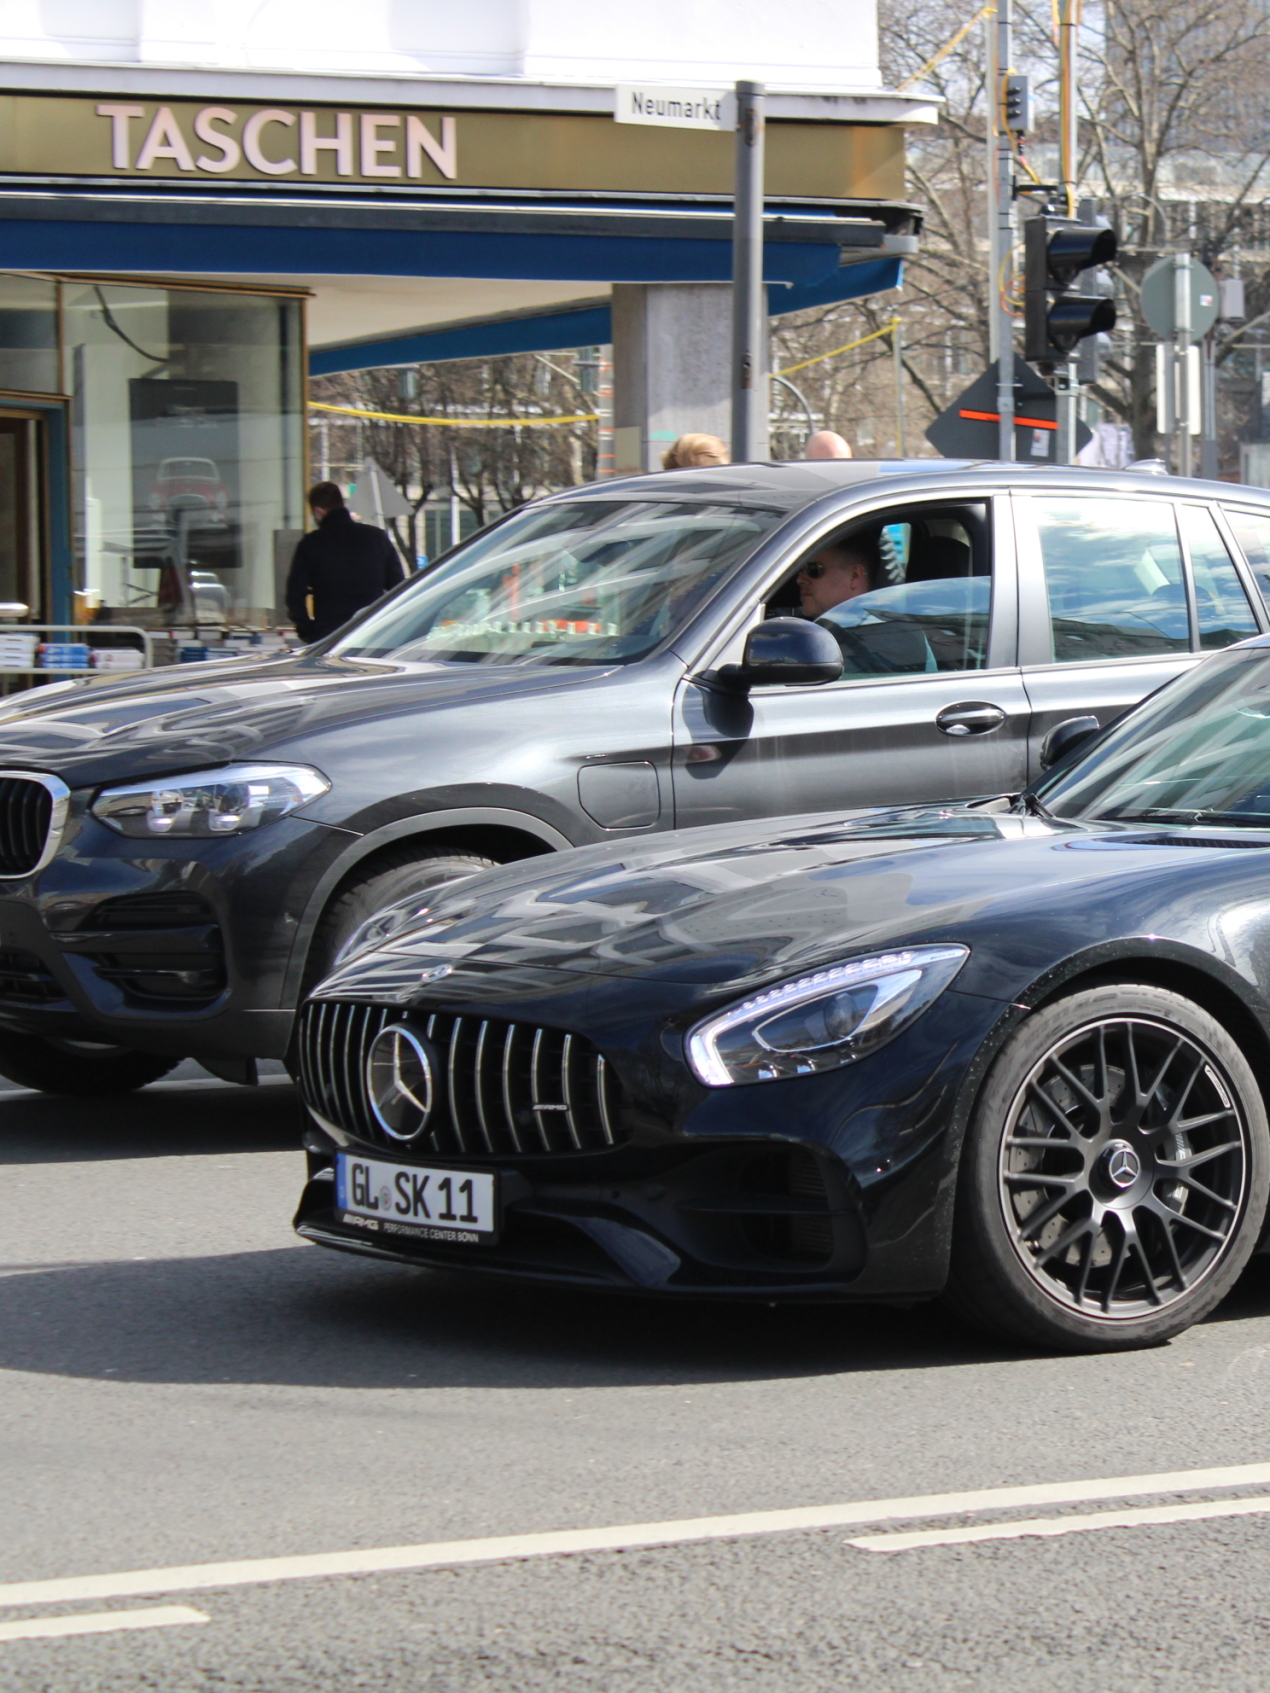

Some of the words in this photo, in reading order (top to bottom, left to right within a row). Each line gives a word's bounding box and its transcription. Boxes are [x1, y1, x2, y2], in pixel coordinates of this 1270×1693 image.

[631, 91, 722, 121] Neumarkt
[96, 104, 457, 180] TASCHEN
[352, 1162, 379, 1210] GL
[395, 1171, 431, 1219] SK
[438, 1177, 478, 1223] 11
[384, 1222, 428, 1238] PERFORMANCE
[430, 1228, 457, 1241] CENTER
[458, 1231, 479, 1243] BONN
